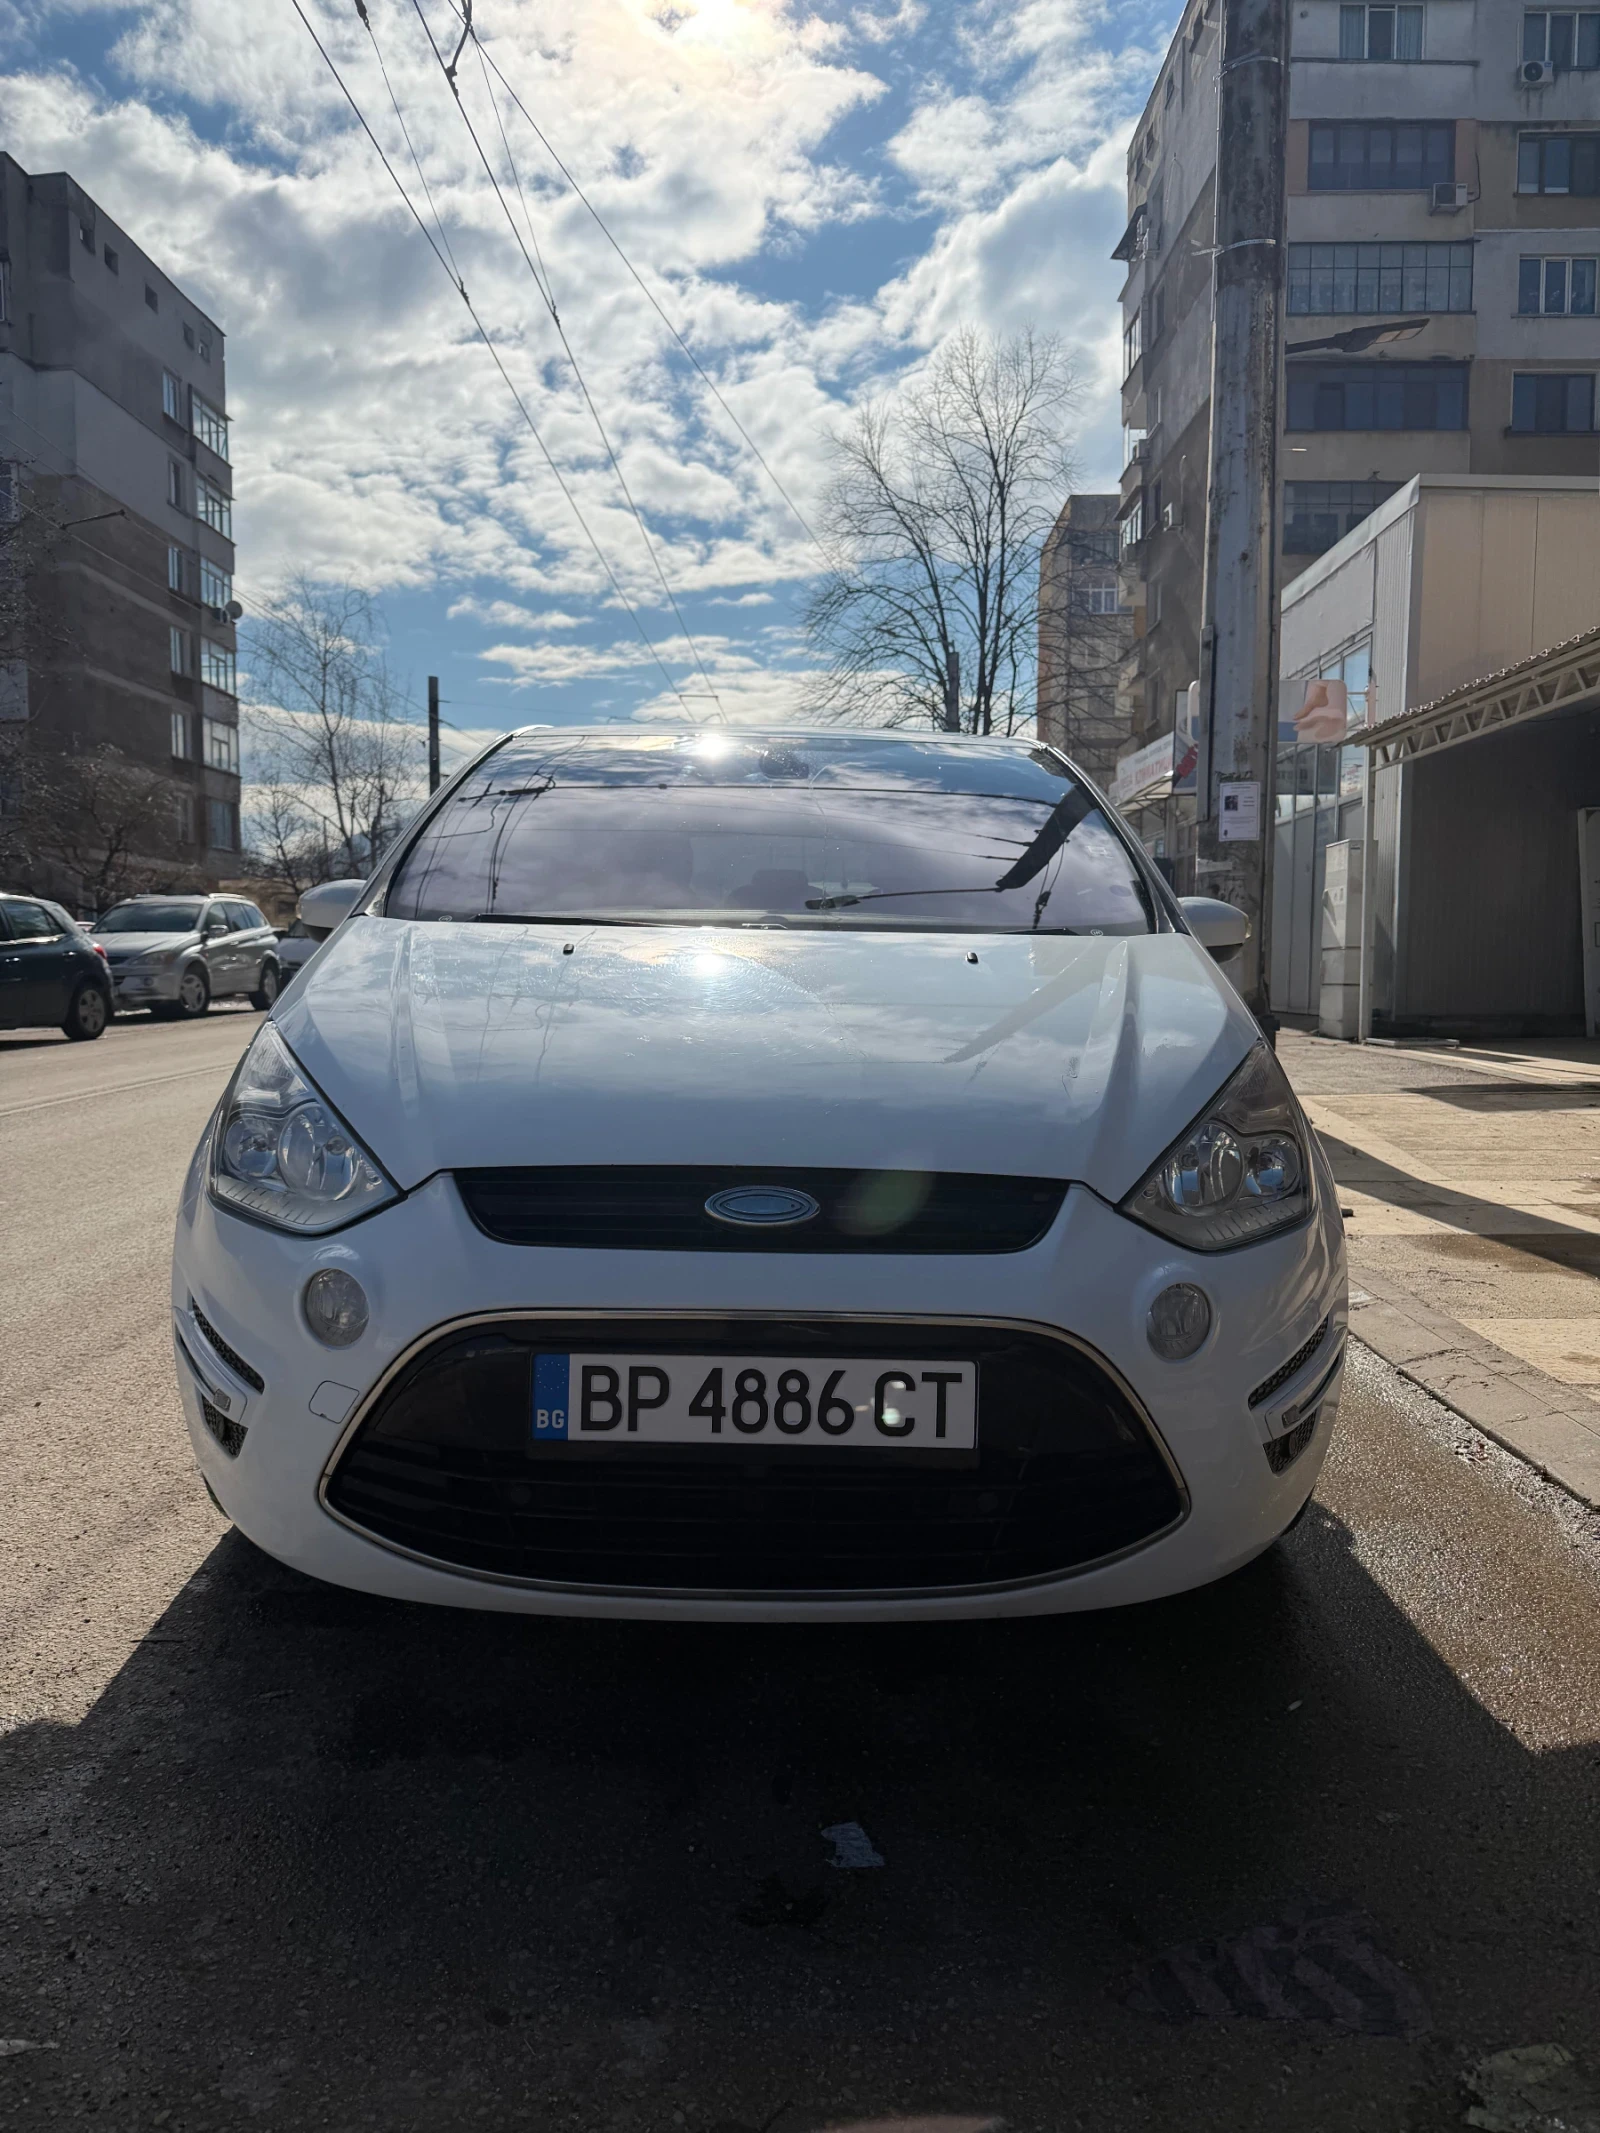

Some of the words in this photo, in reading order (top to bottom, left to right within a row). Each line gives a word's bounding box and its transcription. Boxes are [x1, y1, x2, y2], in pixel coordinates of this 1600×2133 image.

[536, 1409, 565, 1429] BG
[580, 1365, 670, 1432] BP
[688, 1367, 855, 1436] 4886
[874, 1371, 963, 1438] CT
